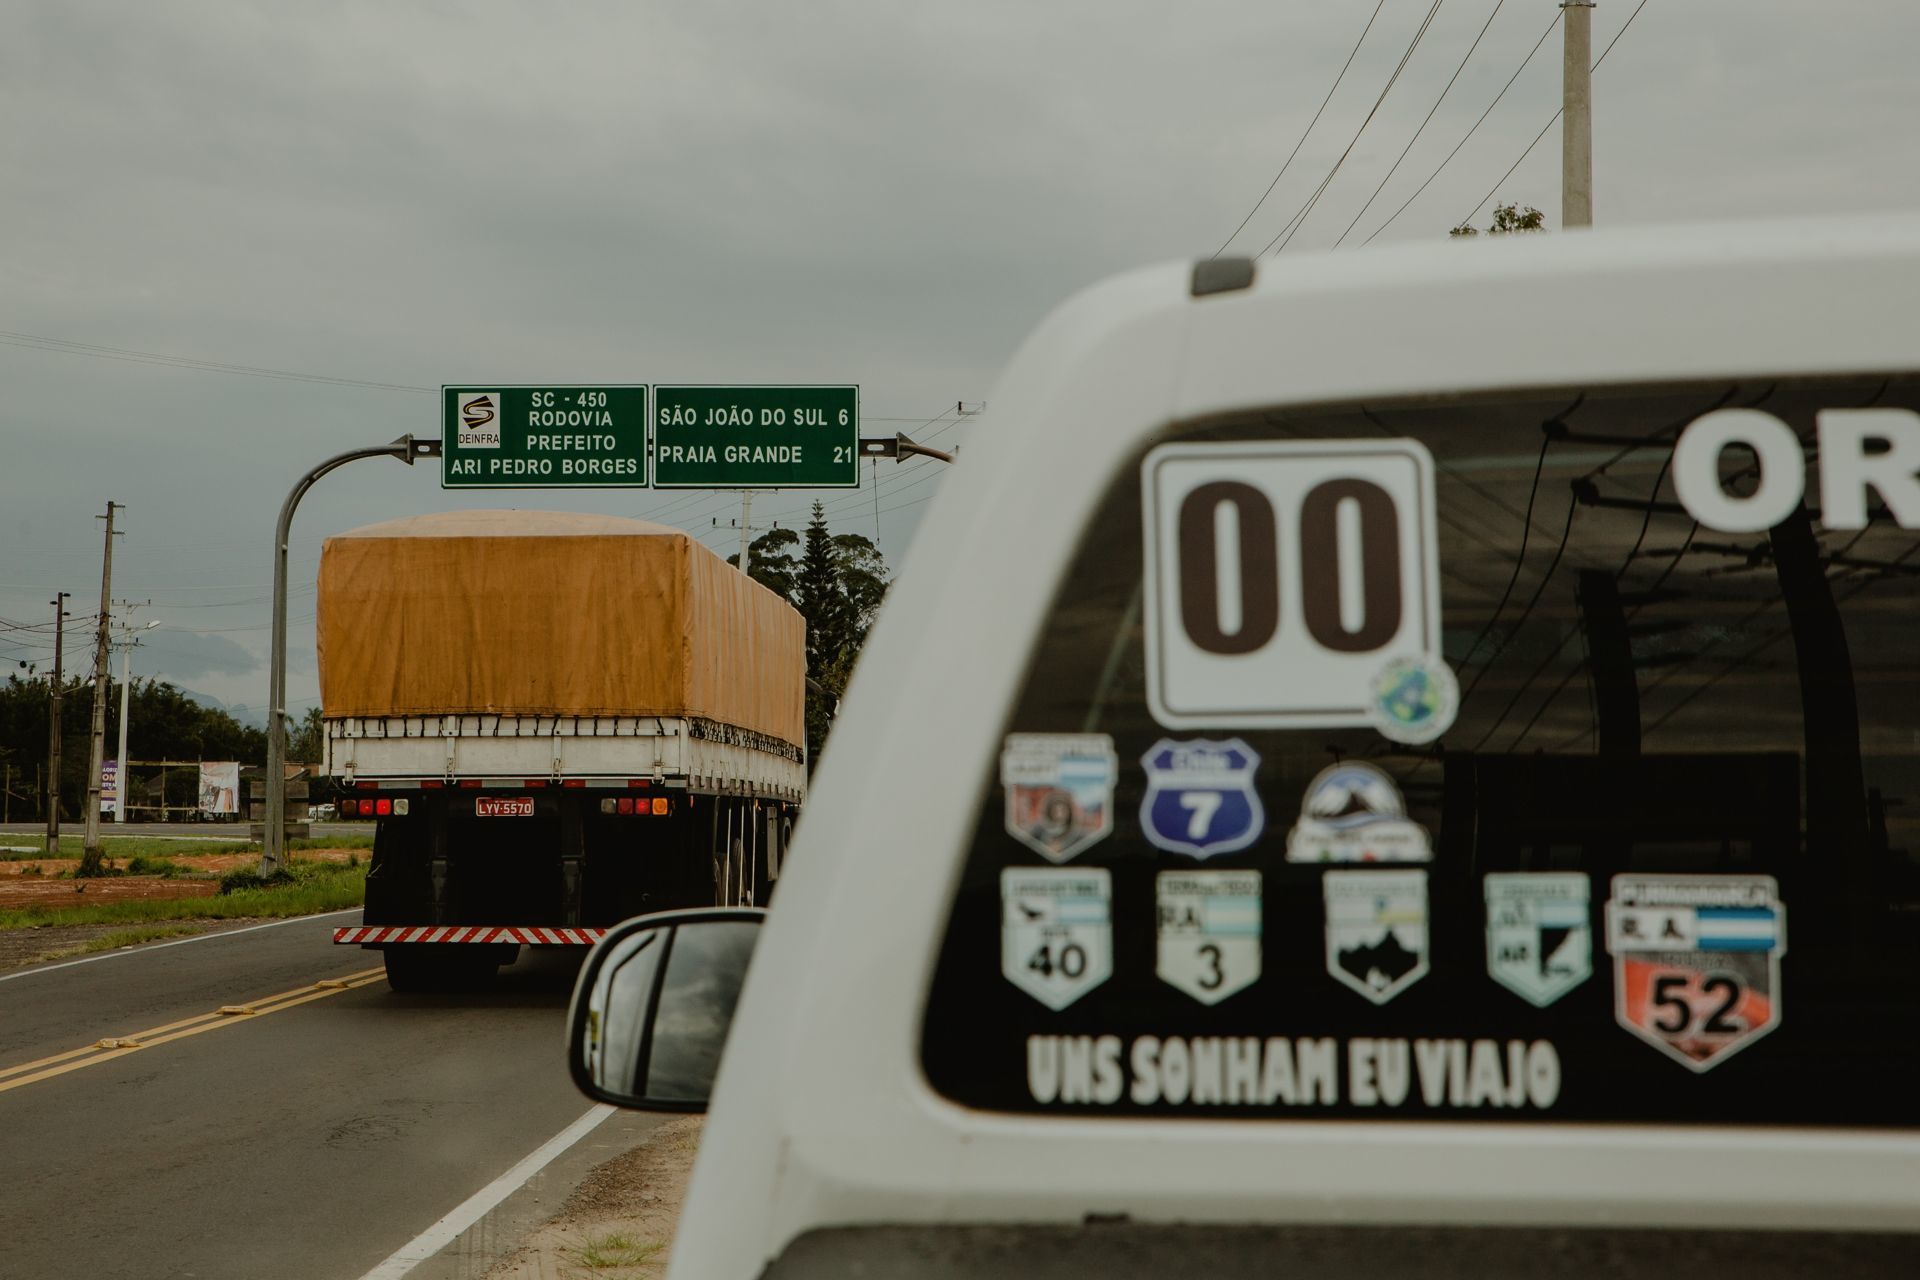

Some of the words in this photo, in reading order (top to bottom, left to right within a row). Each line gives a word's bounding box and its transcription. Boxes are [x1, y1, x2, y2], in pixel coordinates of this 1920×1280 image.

[531, 391, 555, 408] SC
[577, 391, 607, 408] 450
[529, 410, 613, 426] RODOVIA
[660, 404, 697, 426] SÃO
[705, 404, 754, 426] JOÃO
[761, 408, 786, 426] DO
[793, 408, 828, 426] SUL
[838, 408, 849, 426] 6
[459, 433, 500, 444] DEINFRA
[527, 435, 616, 450] PREFEITO
[659, 445, 717, 463] PRAIA
[724, 445, 802, 463] GRANDE
[833, 446, 852, 463] 21
[451, 459, 481, 475] ARI
[490, 459, 553, 475] PEDRO
[562, 459, 637, 474] BORGES
[1178, 477, 1402, 656] 00
[1180, 791, 1223, 839] 7
[1028, 943, 1087, 979] 40
[1198, 943, 1223, 990] 3
[1655, 977, 1740, 1034] 52
[1027, 1035, 1123, 1104] UNS
[1130, 1035, 1338, 1105] SONHAM
[1348, 1037, 1409, 1107] EU
[1415, 1038, 1561, 1109] VIAJO
